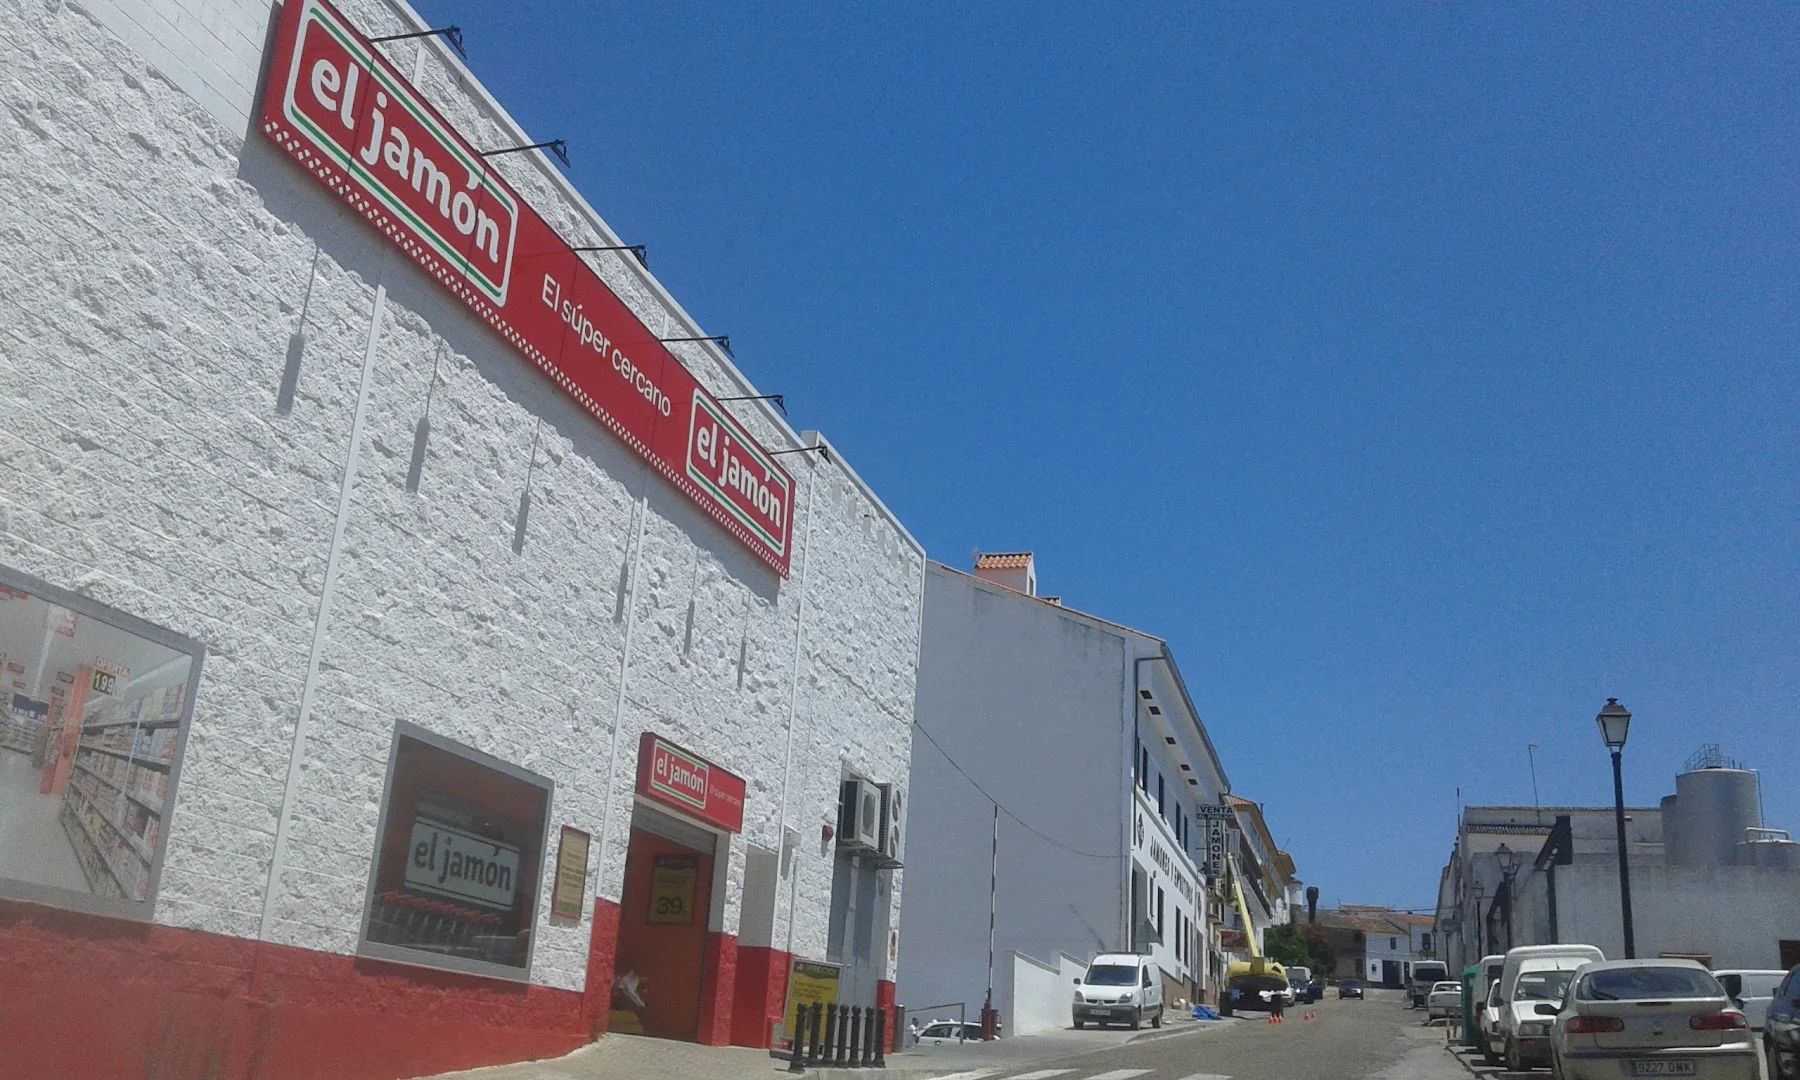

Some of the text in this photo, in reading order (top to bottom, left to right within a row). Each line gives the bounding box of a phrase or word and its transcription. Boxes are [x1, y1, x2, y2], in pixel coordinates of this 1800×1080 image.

[311, 58, 500, 264] el jamón
[541, 273, 671, 417] El súper cercano
[697, 422, 781, 528] el jamón
[95, 657, 130, 678] OFERTA
[656, 752, 704, 794] el jamón
[1200, 806, 1233, 814] VENTA
[414, 832, 438, 872] el
[438, 836, 512, 892] jamón
[1211, 820, 1221, 877] JAMONES
